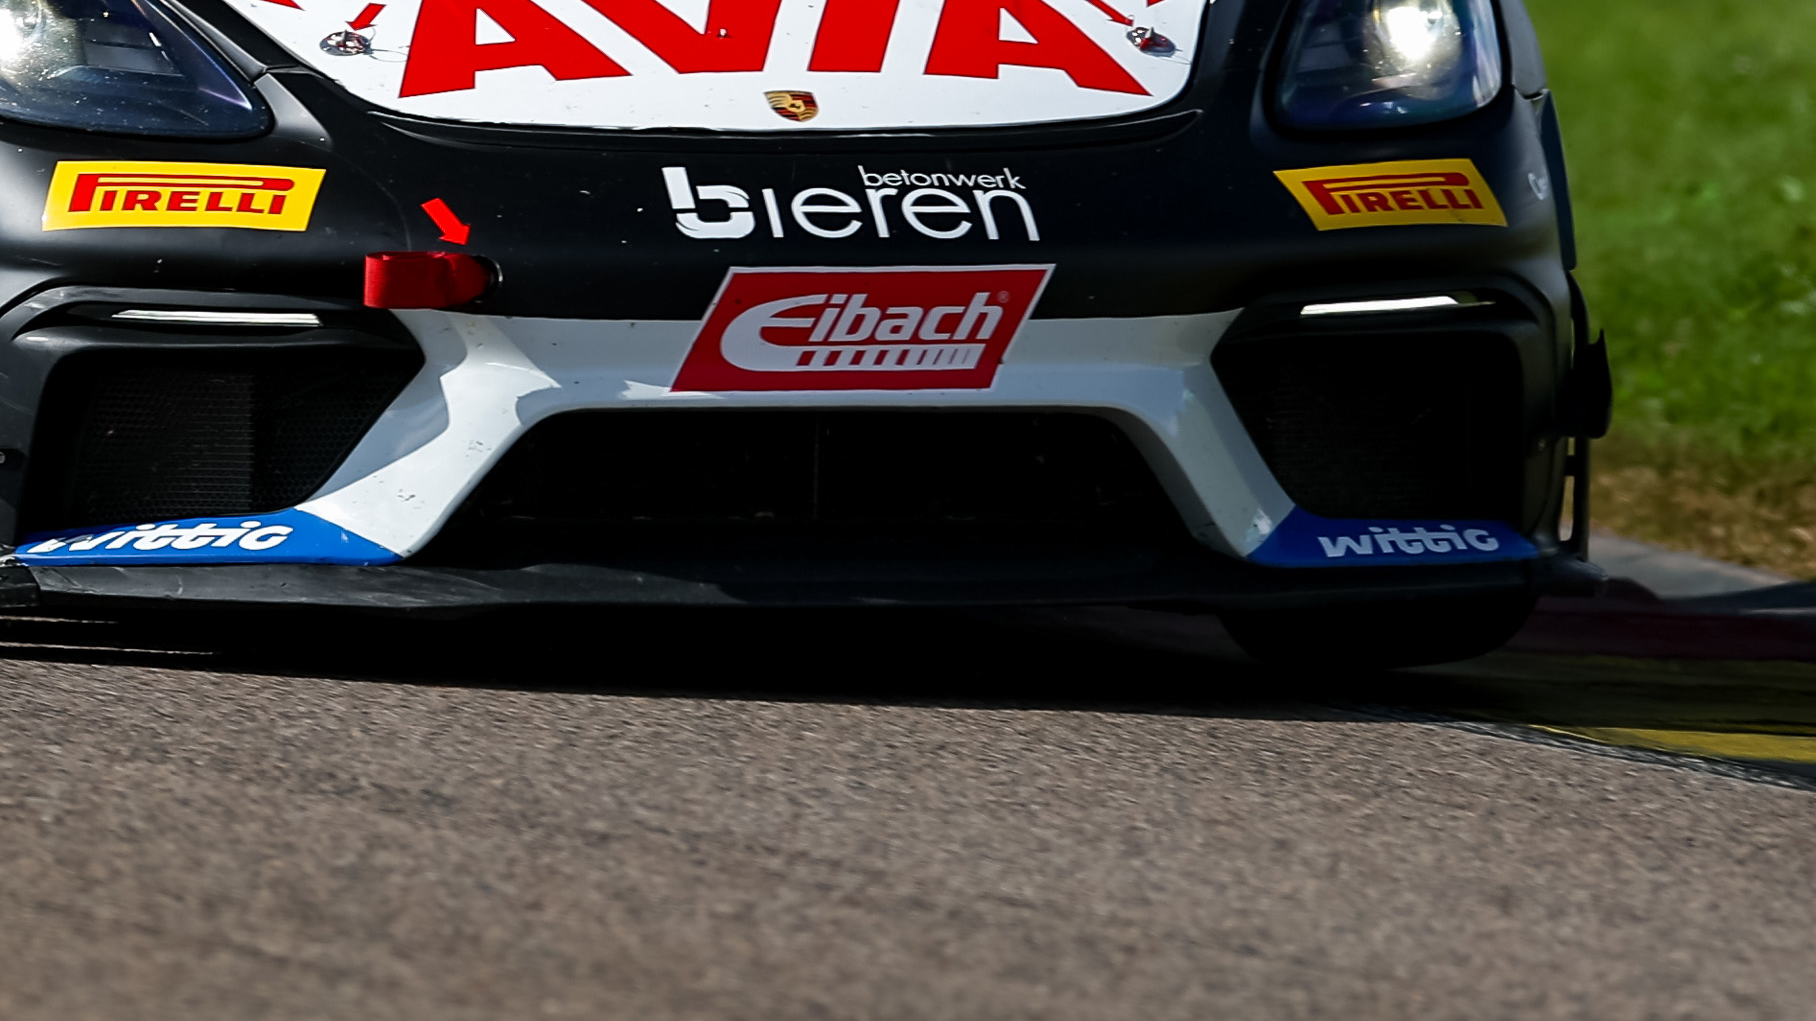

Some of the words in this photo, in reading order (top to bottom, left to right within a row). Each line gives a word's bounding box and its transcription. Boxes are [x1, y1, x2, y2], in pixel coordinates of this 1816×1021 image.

[68, 173, 295, 216] PIRELLI
[857, 165, 1027, 190] betonwerk
[1302, 172, 1483, 216] PIRELLI
[661, 166, 1040, 242] bieren
[719, 291, 1005, 372] Eibach
[1317, 524, 1500, 558] wittic
